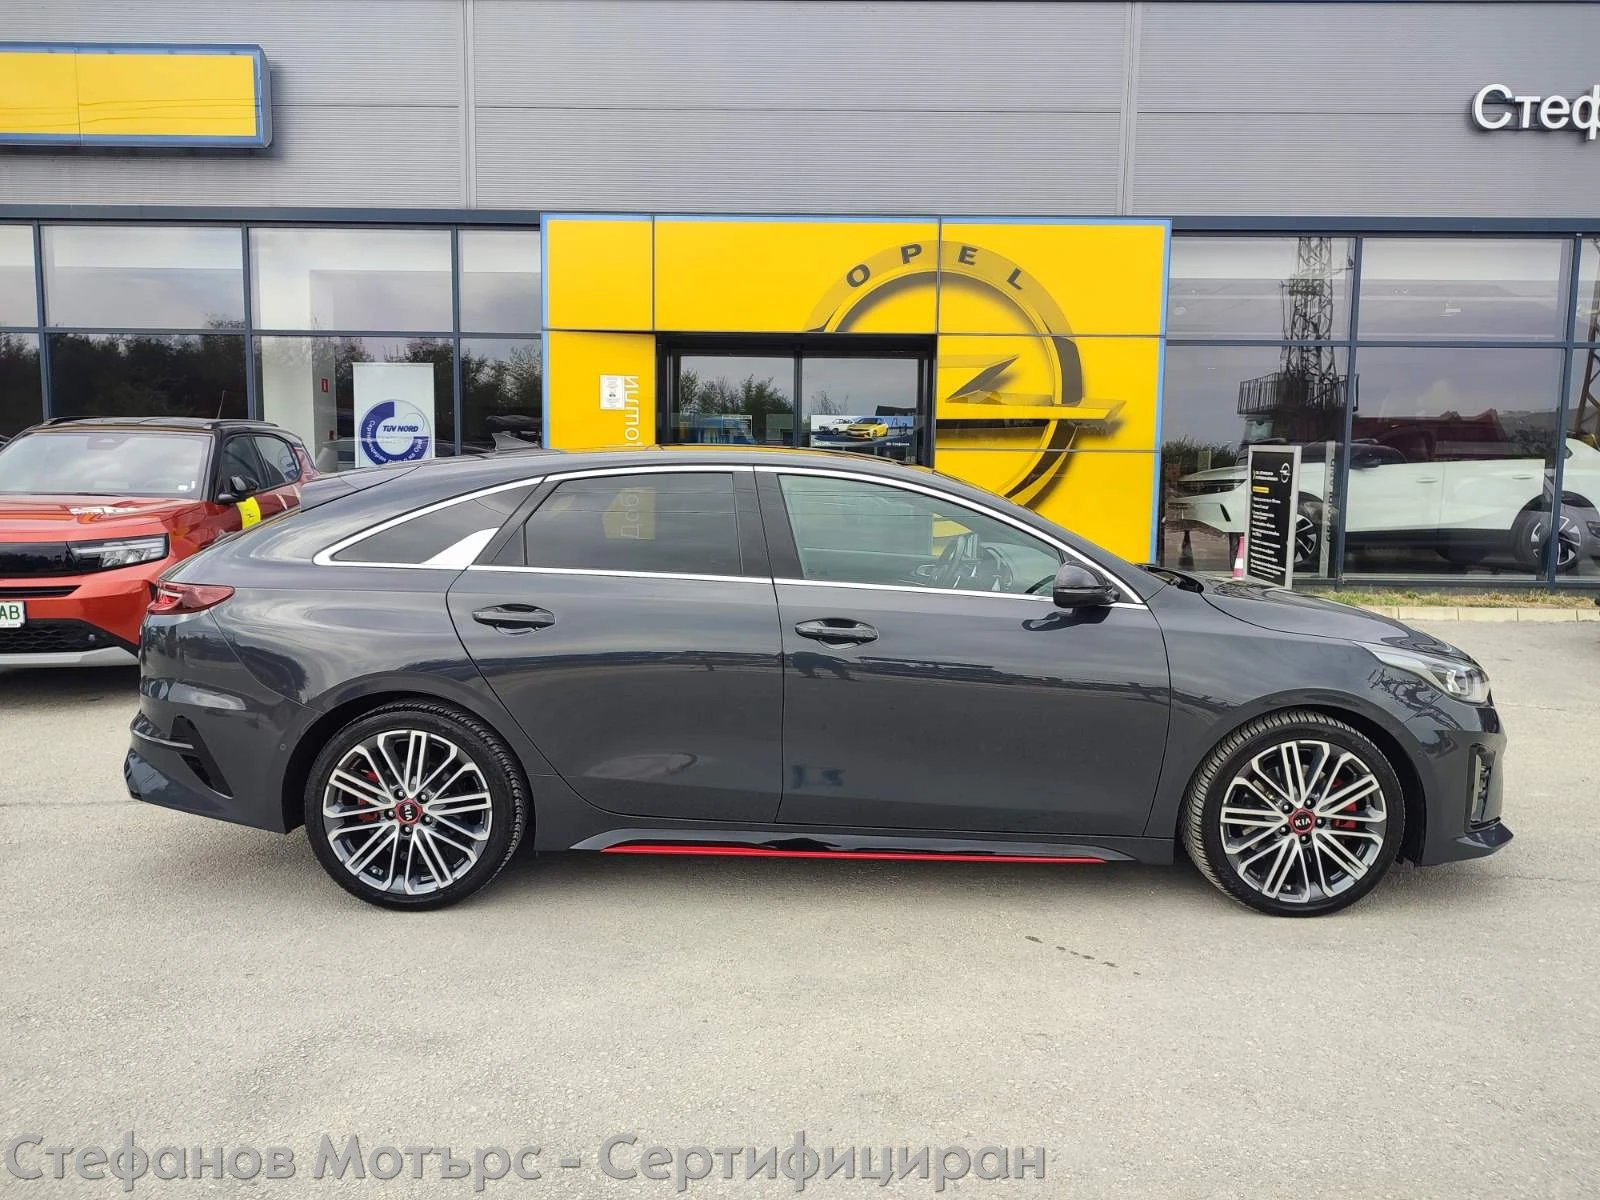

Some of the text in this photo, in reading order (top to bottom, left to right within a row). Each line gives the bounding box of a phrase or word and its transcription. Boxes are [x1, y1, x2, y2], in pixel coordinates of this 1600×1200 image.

[1473, 83, 1600, 140] Стеф
[846, 243, 1024, 290] OPEL
[624, 374, 643, 447] ошли
[0, 605, 20, 620] AB
[1295, 818, 1311, 827] KIA
